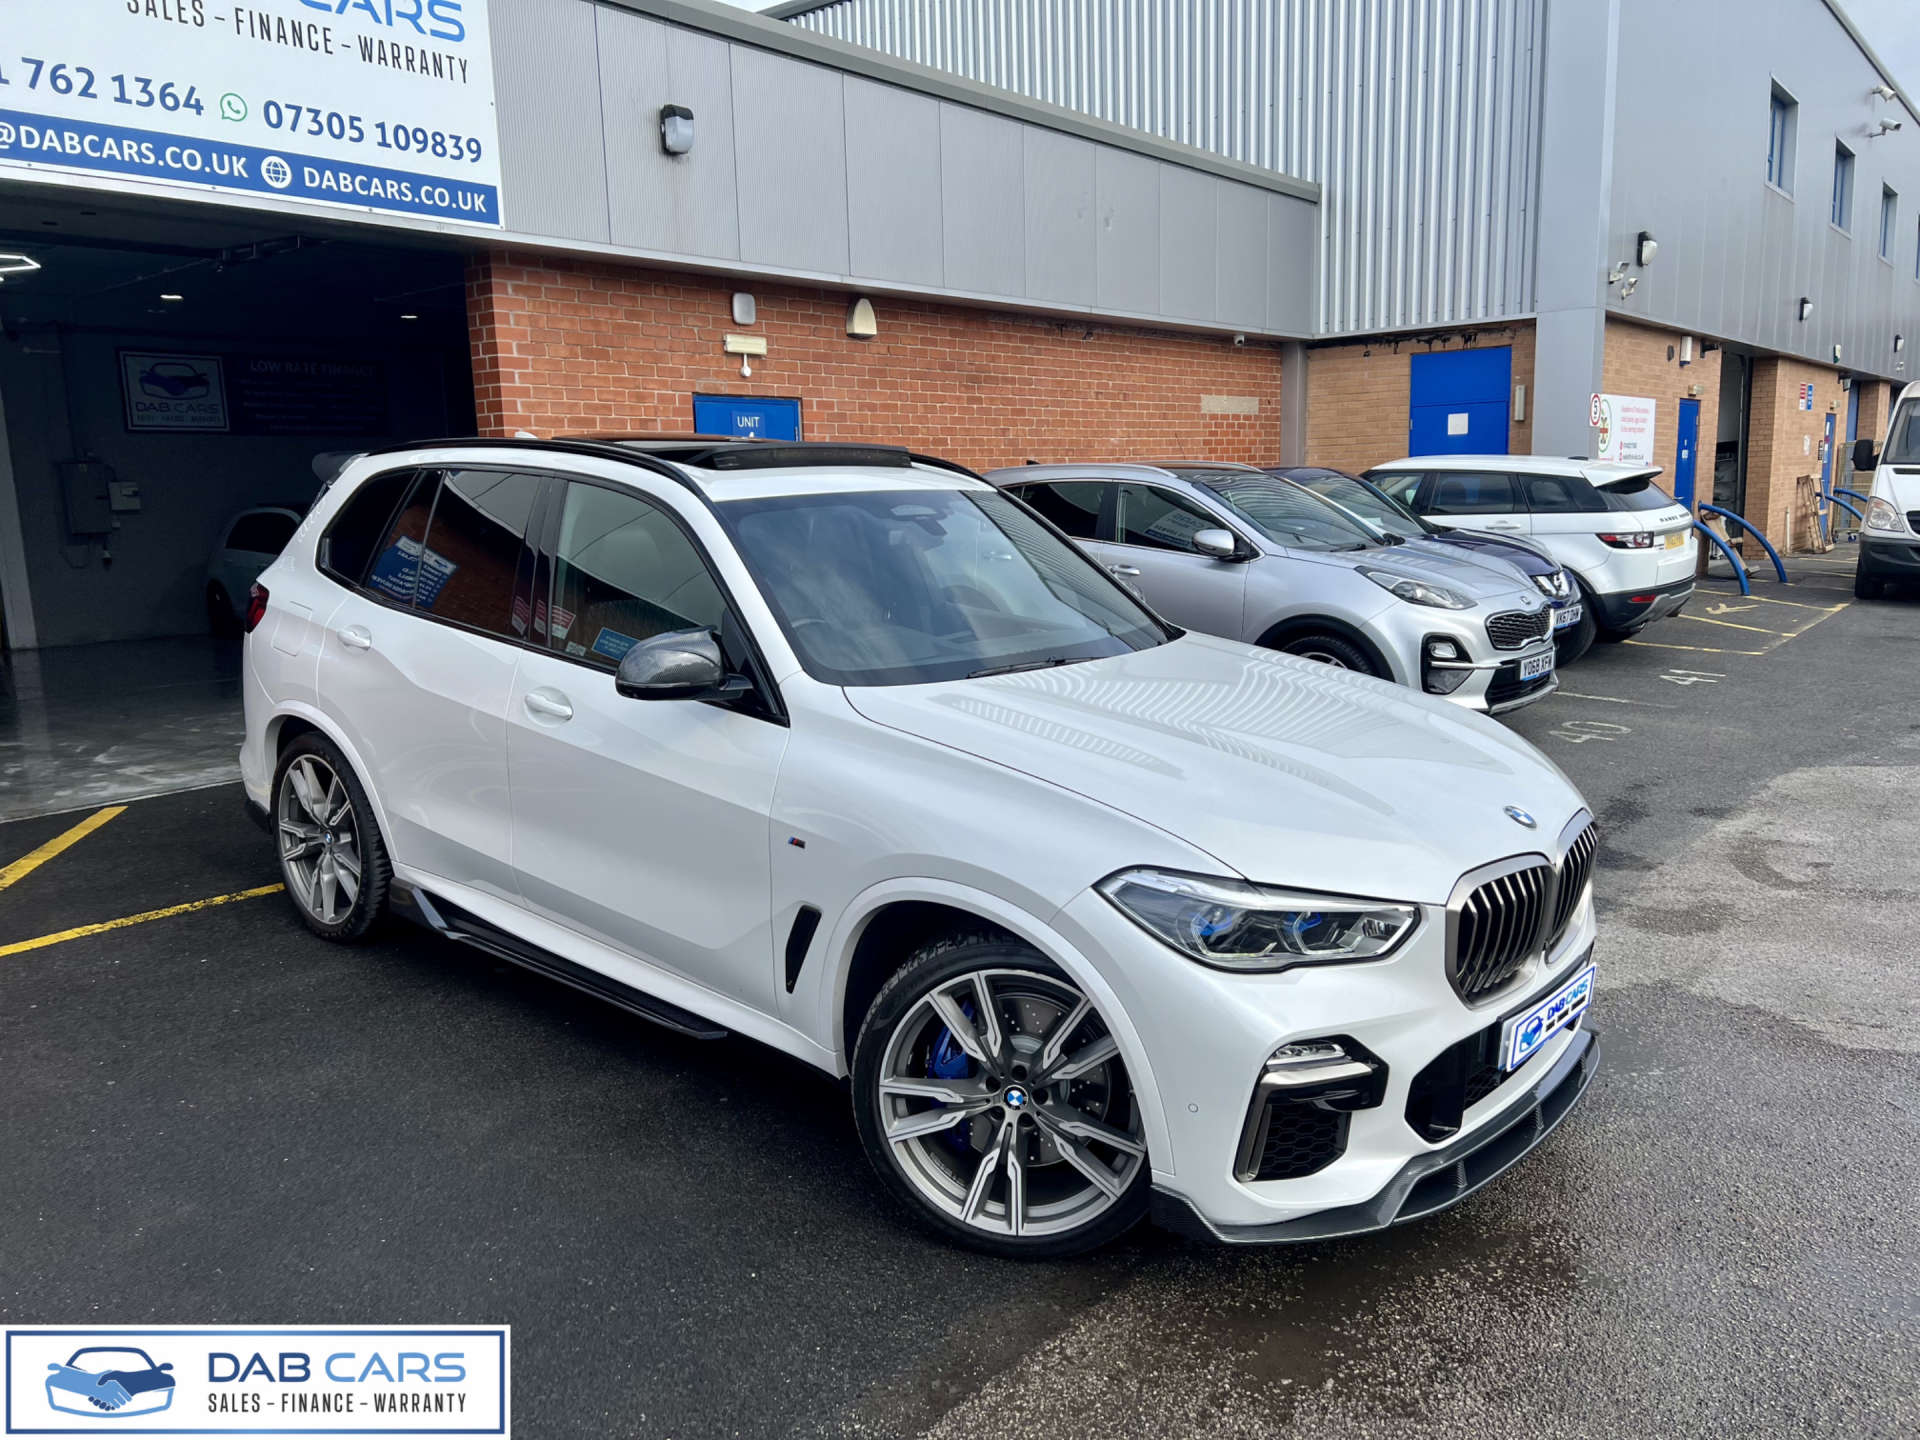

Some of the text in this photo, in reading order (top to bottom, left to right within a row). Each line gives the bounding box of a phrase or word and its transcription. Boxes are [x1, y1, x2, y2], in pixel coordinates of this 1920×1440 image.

[235, 7, 333, 55] FINANCE
[358, 35, 467, 84] WARRANTY
[21, 56, 98, 99] 762
[111, 73, 205, 116] 1364
[263, 100, 365, 143] 07305
[375, 121, 482, 163] 109839
[303, 166, 487, 213] DABCARS.CO.UK
[136, 402, 219, 415] DAB CARS
[737, 416, 760, 428] UNIT
[1547, 997, 1565, 1020] DAB
